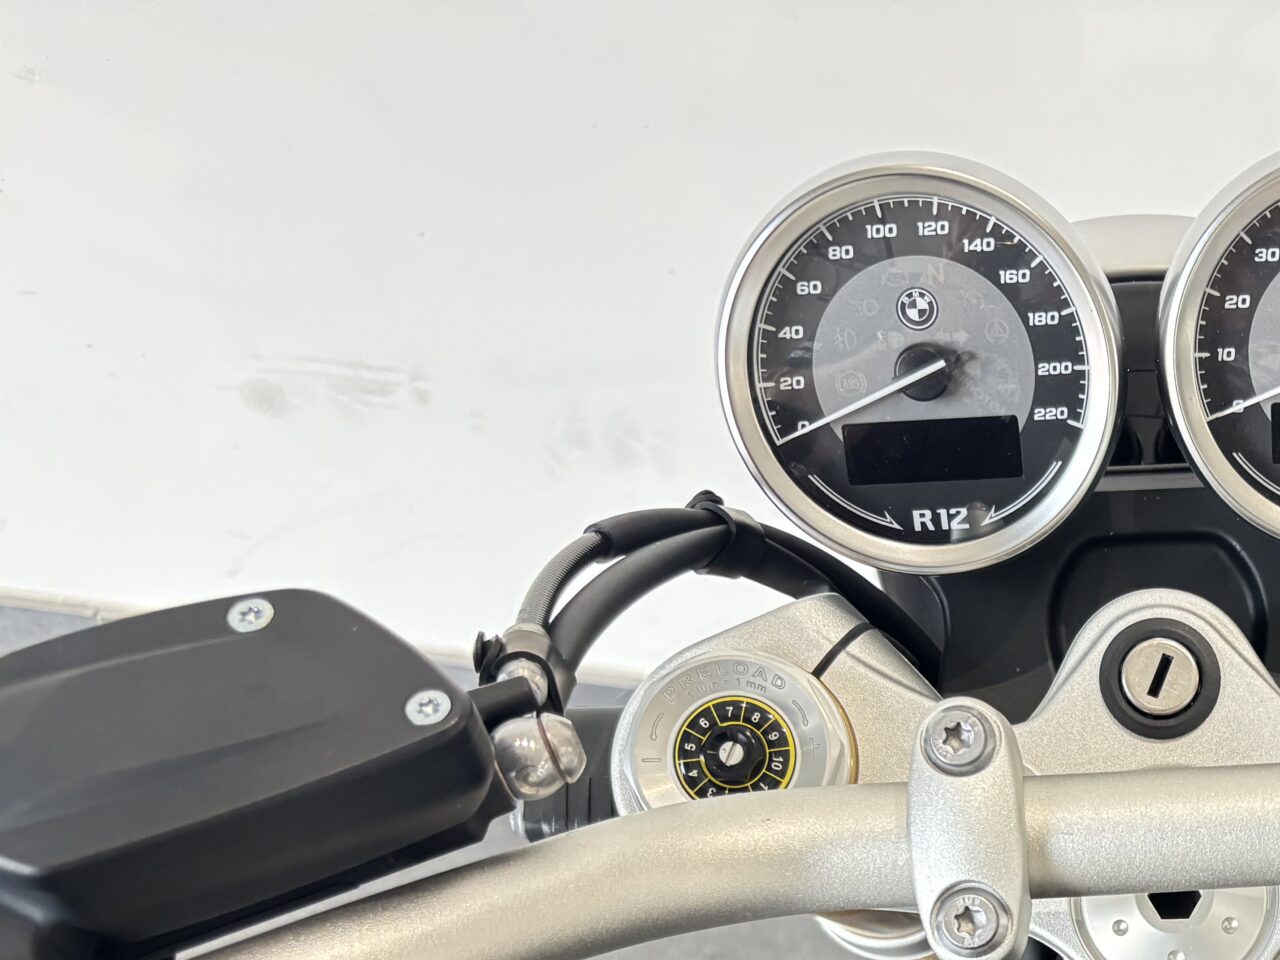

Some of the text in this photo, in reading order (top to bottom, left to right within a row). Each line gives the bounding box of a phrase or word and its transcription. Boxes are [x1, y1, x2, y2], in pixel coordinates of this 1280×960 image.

[865, 223, 898, 239] 100
[917, 221, 949, 236] 120
[828, 245, 854, 260] 80
[962, 237, 995, 253] 140
[1254, 248, 1280, 262] 30
[999, 269, 1030, 284] 160
[796, 281, 822, 295] 60
[902, 291, 931, 304] BMW
[1224, 294, 1250, 309] 20
[1028, 311, 1059, 326] 180
[778, 326, 804, 340] 40
[1217, 347, 1235, 362] 10
[1037, 361, 1073, 376] 200
[779, 376, 805, 390] 20
[1033, 406, 1068, 421] 220
[663, 662, 786, 704] PRELOAD
[725, 706, 734, 718] 7
[751, 712, 761, 723] 8
[699, 717, 710, 728] 6
[768, 731, 780, 741] 9
[684, 742, 696, 752] 5
[771, 752, 784, 771] 10
[687, 769, 698, 777] 4
